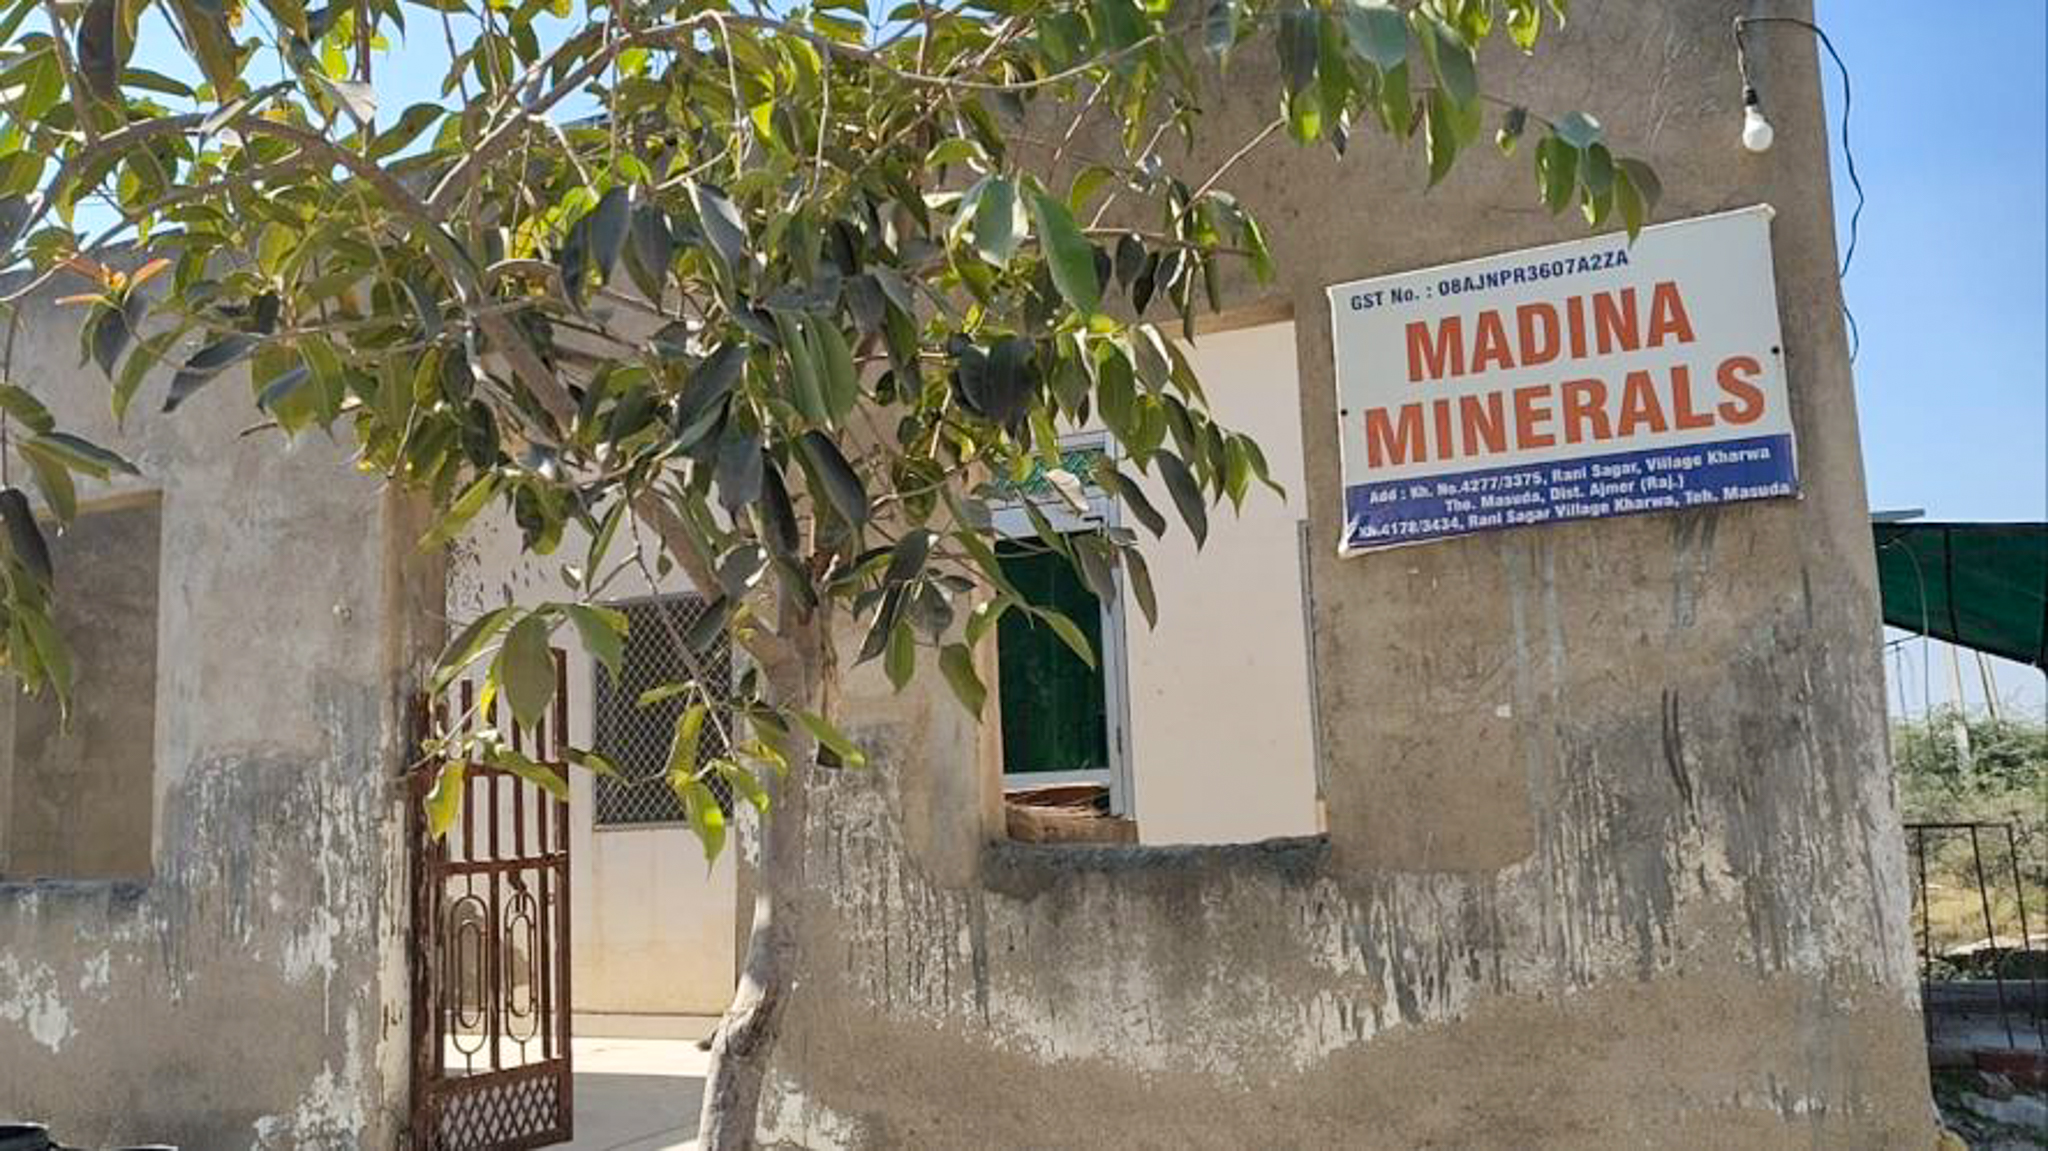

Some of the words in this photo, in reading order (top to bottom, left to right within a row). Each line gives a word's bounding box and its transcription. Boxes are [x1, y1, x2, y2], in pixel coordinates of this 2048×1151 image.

[1351, 290, 1383, 311] GST
[1390, 289, 1419, 305] No.
[1407, 281, 1693, 382] MADINA
[1366, 355, 1764, 468] MINERALS
[1370, 489, 1397, 503] Add
[1552, 466, 1586, 482] Rani
[1591, 462, 1641, 479] Sagar,
[1646, 453, 1702, 470] Village
[1707, 447, 1770, 465] Kharwa
[1550, 485, 1585, 501] Dist.
[1590, 479, 1635, 497] Ajmer
[1641, 473, 1684, 493] (Raj.)
[1469, 511, 1502, 528] Rani
[1506, 508, 1550, 524] Sagar
[1554, 501, 1609, 518] Village
[1723, 482, 1790, 500] Masuda
